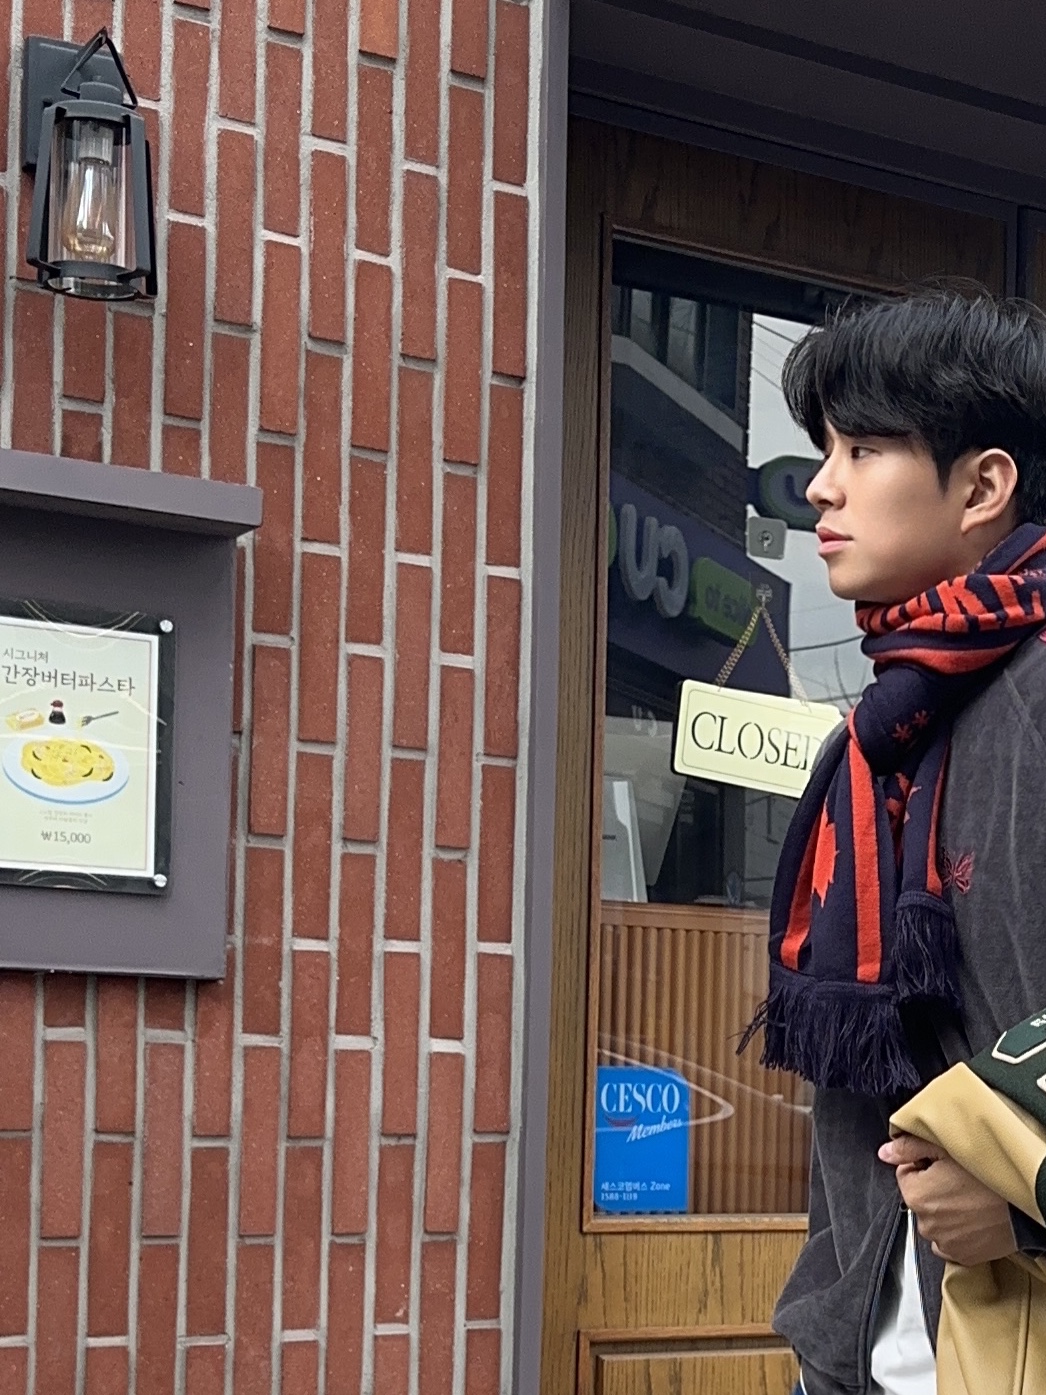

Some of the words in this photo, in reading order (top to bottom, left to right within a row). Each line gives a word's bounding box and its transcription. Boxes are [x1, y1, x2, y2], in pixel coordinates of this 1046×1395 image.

[3, 647, 49, 664] 시그니처
[1, 664, 136, 697] 간장버터파스타
[600, 1082, 681, 1114] CESCO
[626, 1114, 683, 1144] Members
[650, 1181, 671, 1191] Zone
